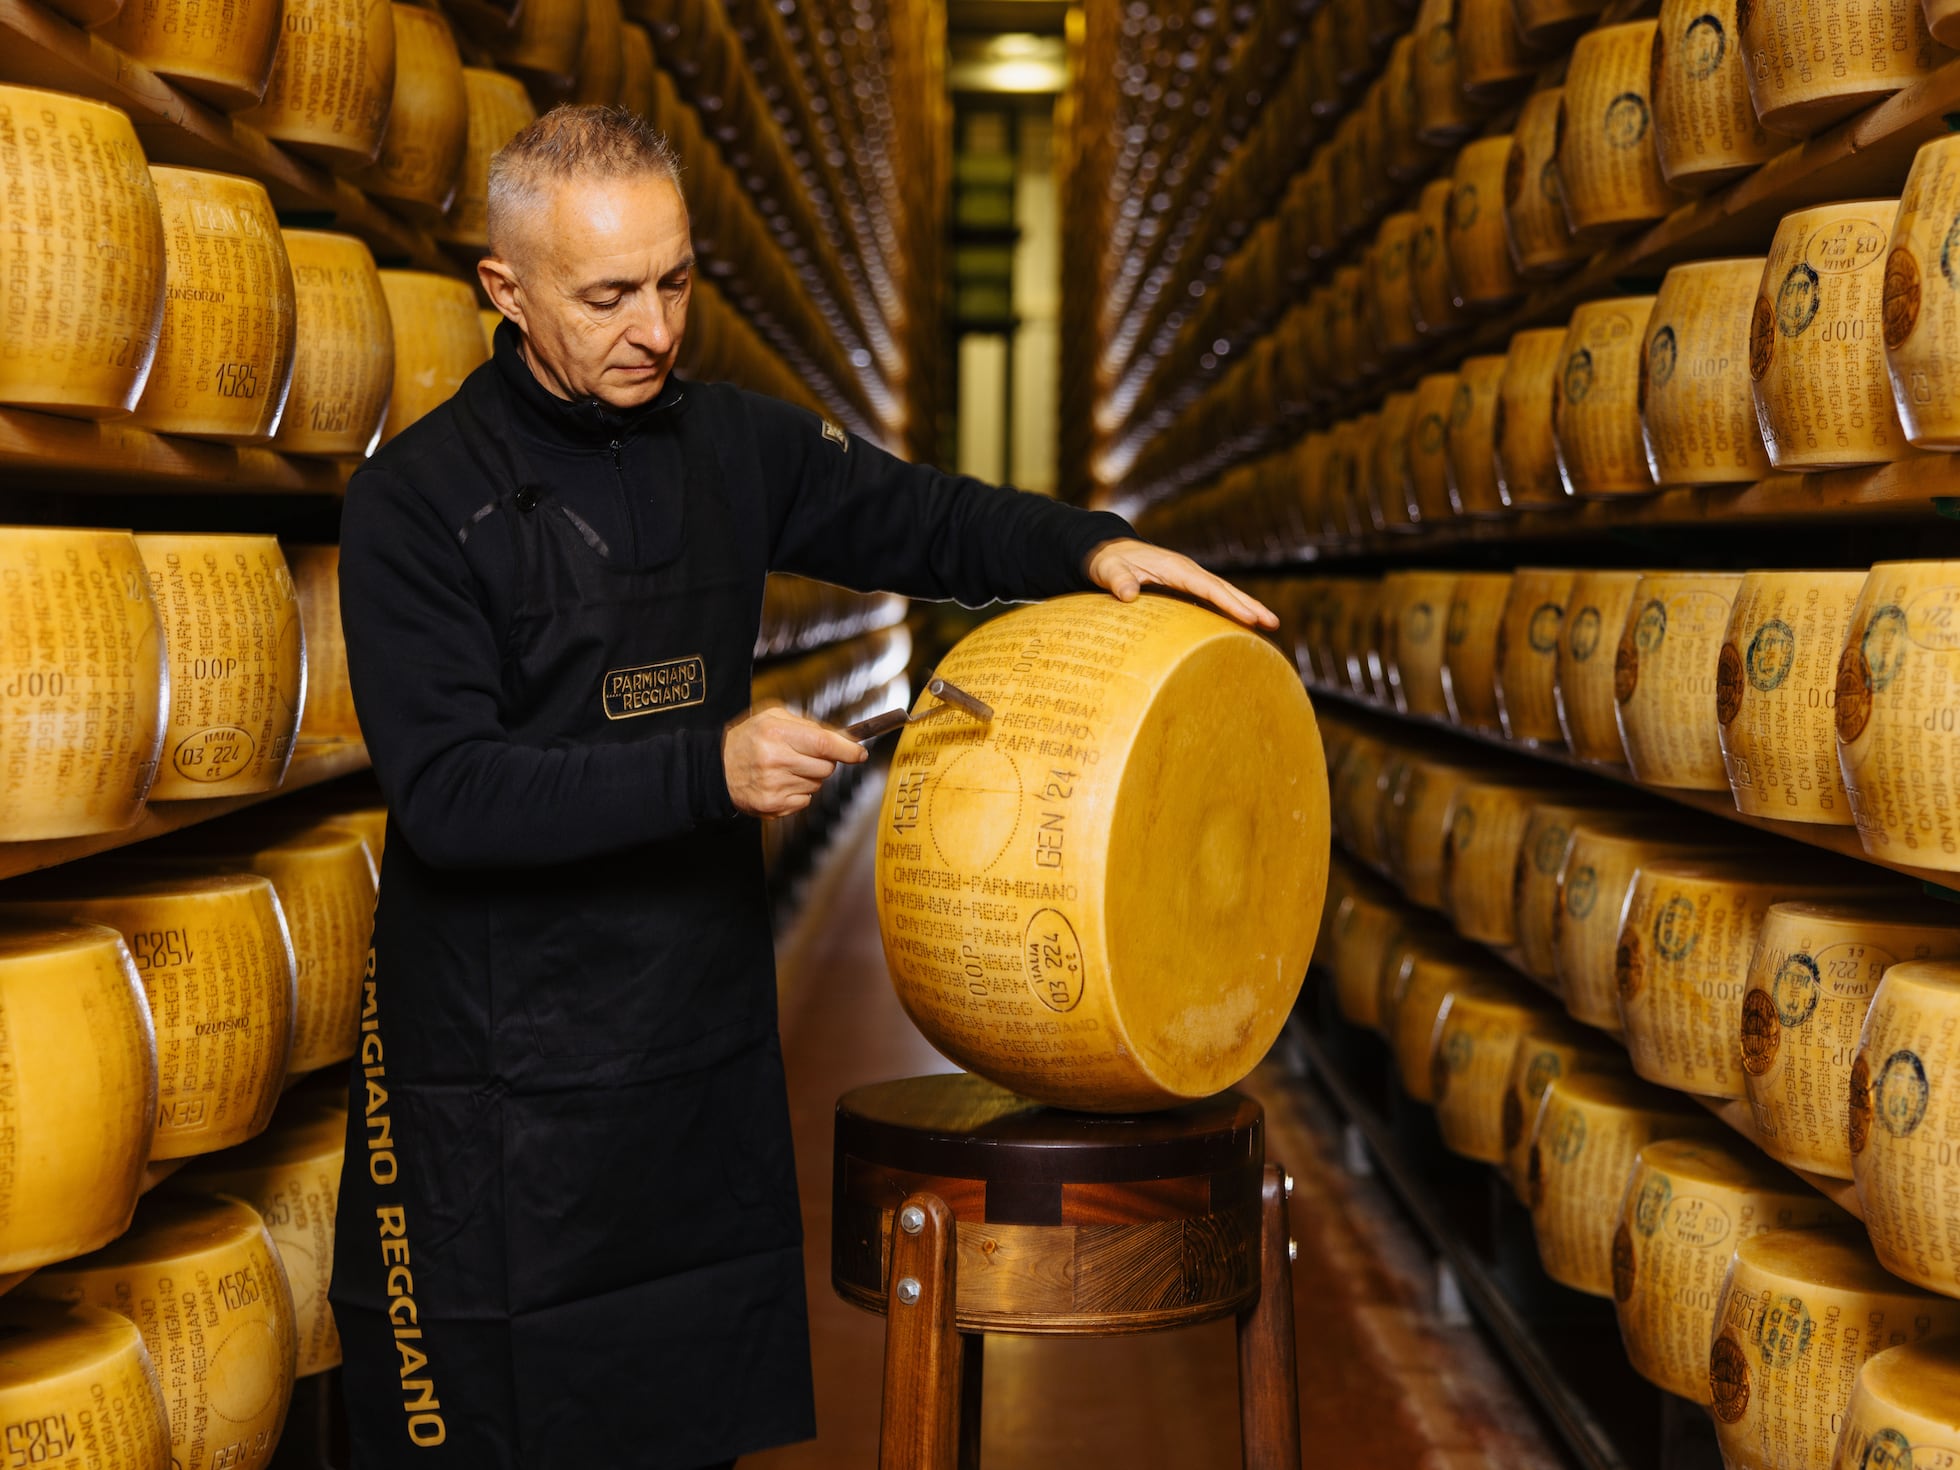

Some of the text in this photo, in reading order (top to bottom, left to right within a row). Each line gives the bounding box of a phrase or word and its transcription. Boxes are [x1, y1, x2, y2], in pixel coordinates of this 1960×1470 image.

[215, 362, 259, 399] 1585
[612, 663, 697, 694] PARMIGIANO
[622, 682, 691, 711] REGGIANO
[204, 732, 236, 745] ITALIA
[181, 745, 241, 767] 03 224
[206, 766, 222, 777] CE
[892, 771, 929, 836] 1585
[1035, 811, 1066, 870] GEN
[970, 874, 1079, 902] PARMIGIANO
[971, 902, 1019, 923] REGG
[133, 928, 195, 971] 1585
[1028, 942, 1046, 985] ITALIA
[1042, 932, 1070, 1004] 03 224
[1828, 960, 1859, 979] 224
[158, 1100, 206, 1130] GEN
[361, 946, 447, 1449] RMIGIANO REGGIANO
[217, 1266, 261, 1313] 1585
[5, 1413, 76, 1469] 1585
